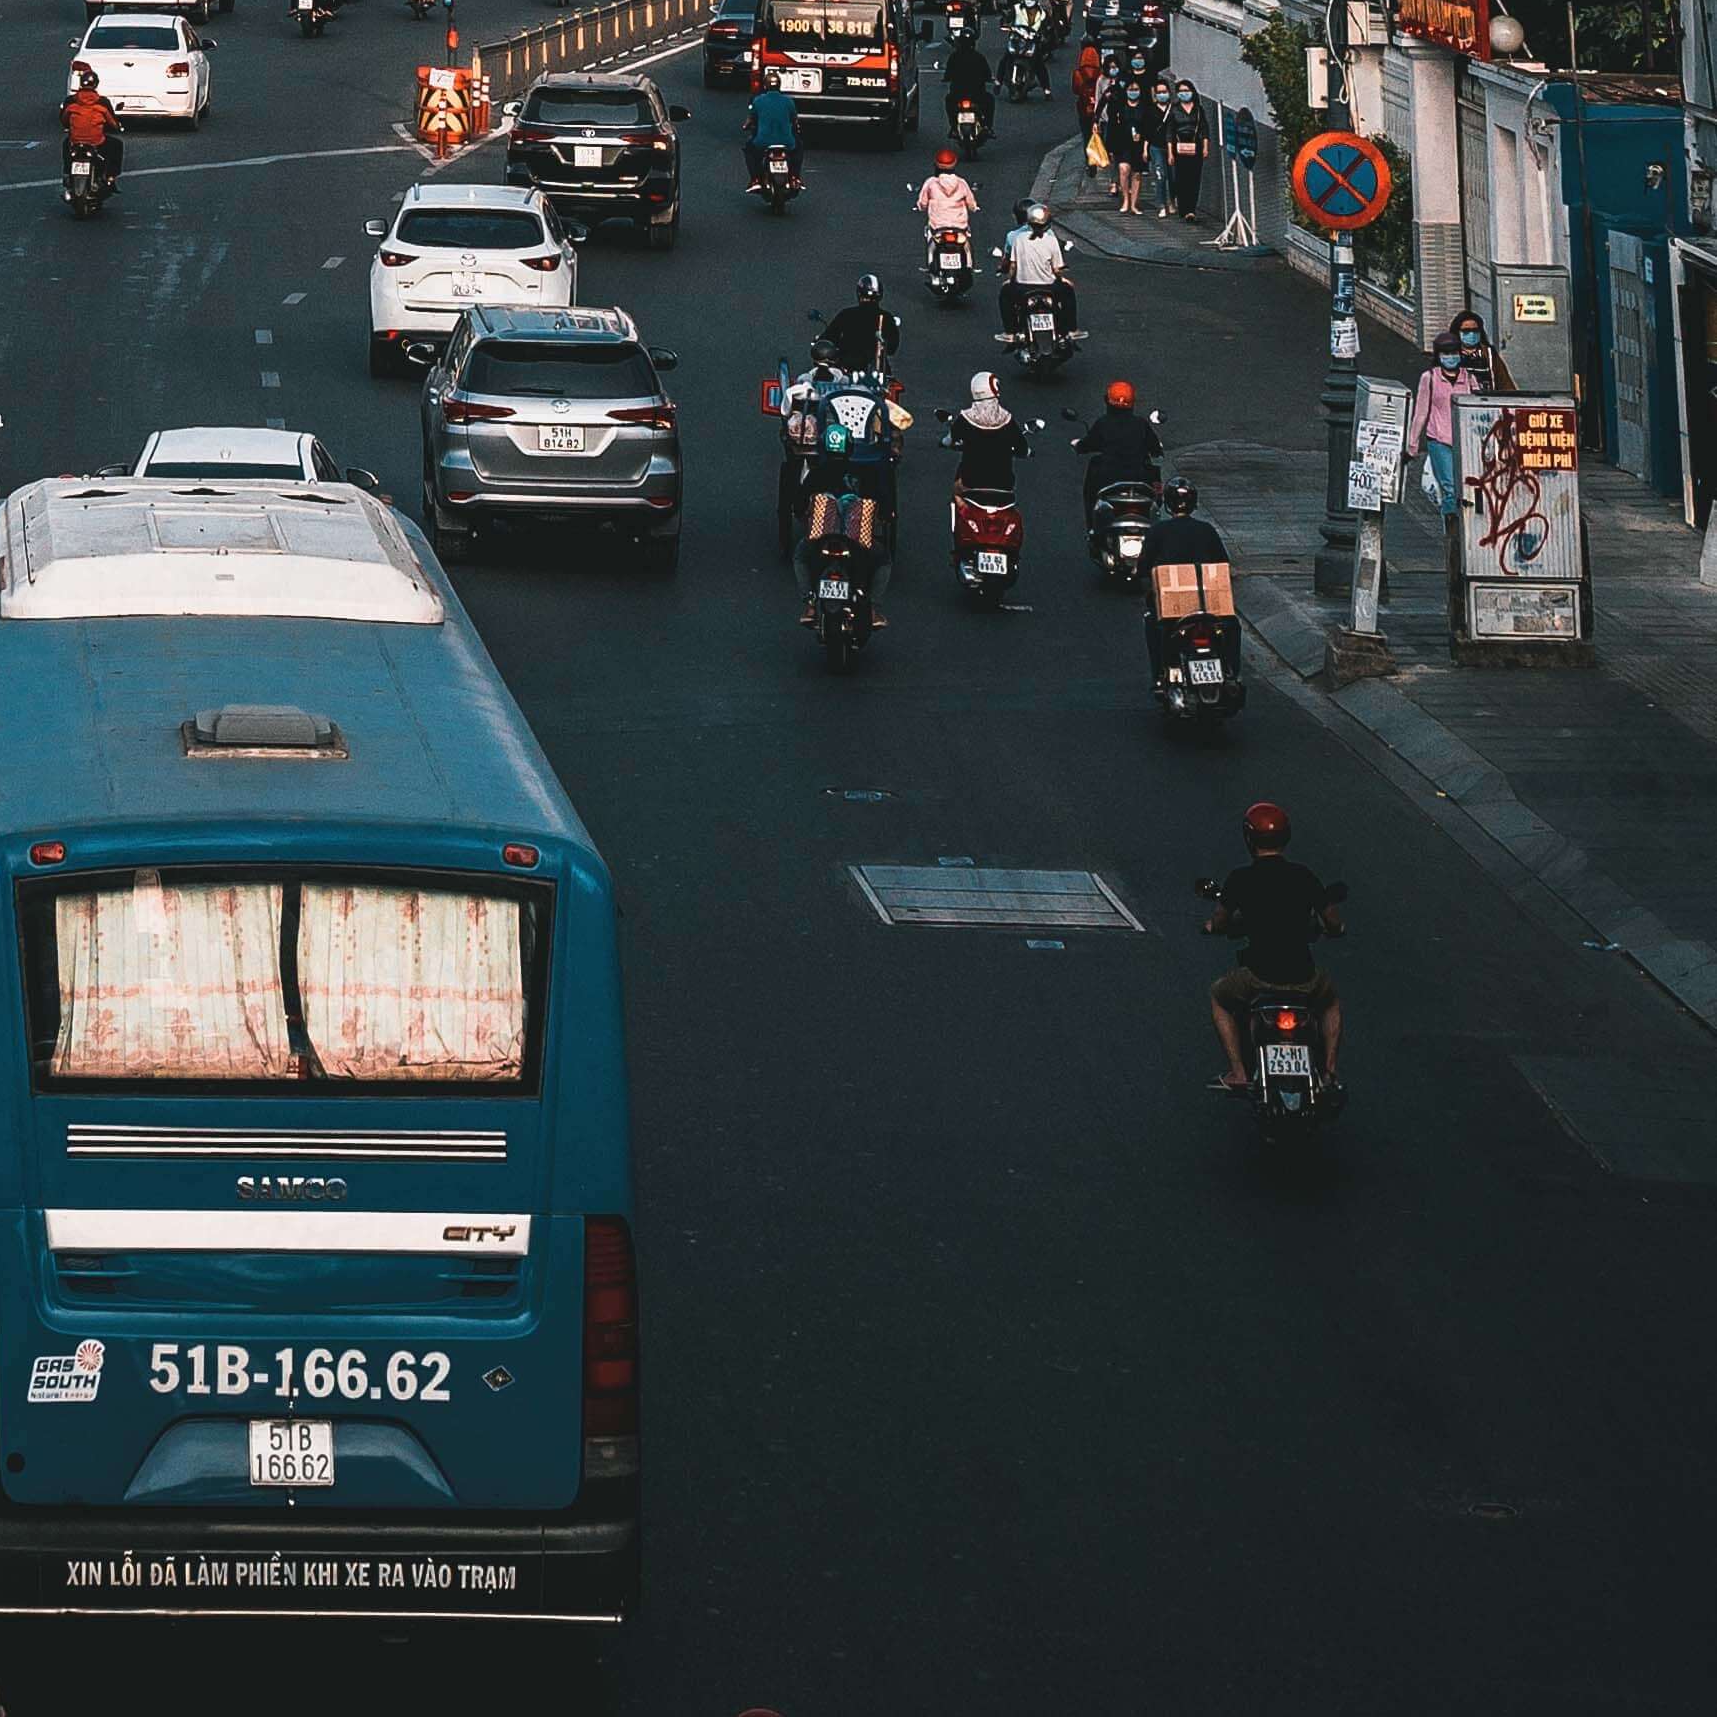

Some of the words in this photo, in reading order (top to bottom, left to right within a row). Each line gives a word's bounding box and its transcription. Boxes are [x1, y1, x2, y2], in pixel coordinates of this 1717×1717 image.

[780, 19, 810, 33] 1900
[1528, 412, 1548, 429] GIỮ
[1549, 414, 1563, 428] XE
[552, 427, 572, 438] 51H
[1519, 431, 1548, 448] BỆNH
[1550, 432, 1575, 448] VIỆN
[1553, 450, 1573, 467] PHÍ
[236, 1175, 347, 1202] SAMCO
[442, 1223, 517, 1245] CITY
[36, 1358, 76, 1373] GAS
[149, 1343, 451, 1401] 51B-166.62
[33, 1375, 97, 1389] SOUTH
[269, 1424, 312, 1451] 51B
[254, 1453, 329, 1481] 166.62
[66, 1561, 103, 1587] XIN
[109, 1550, 143, 1587] LỖI
[149, 1555, 178, 1587] ĐÃ
[184, 1555, 229, 1587] LÀM
[235, 1551, 298, 1588] PHIỀN
[303, 1561, 339, 1587] KHI
[344, 1562, 371, 1587] XE
[378, 1562, 406, 1588] RA
[411, 1557, 452, 1589] VÀO
[458, 1564, 517, 1595] TRẠM
